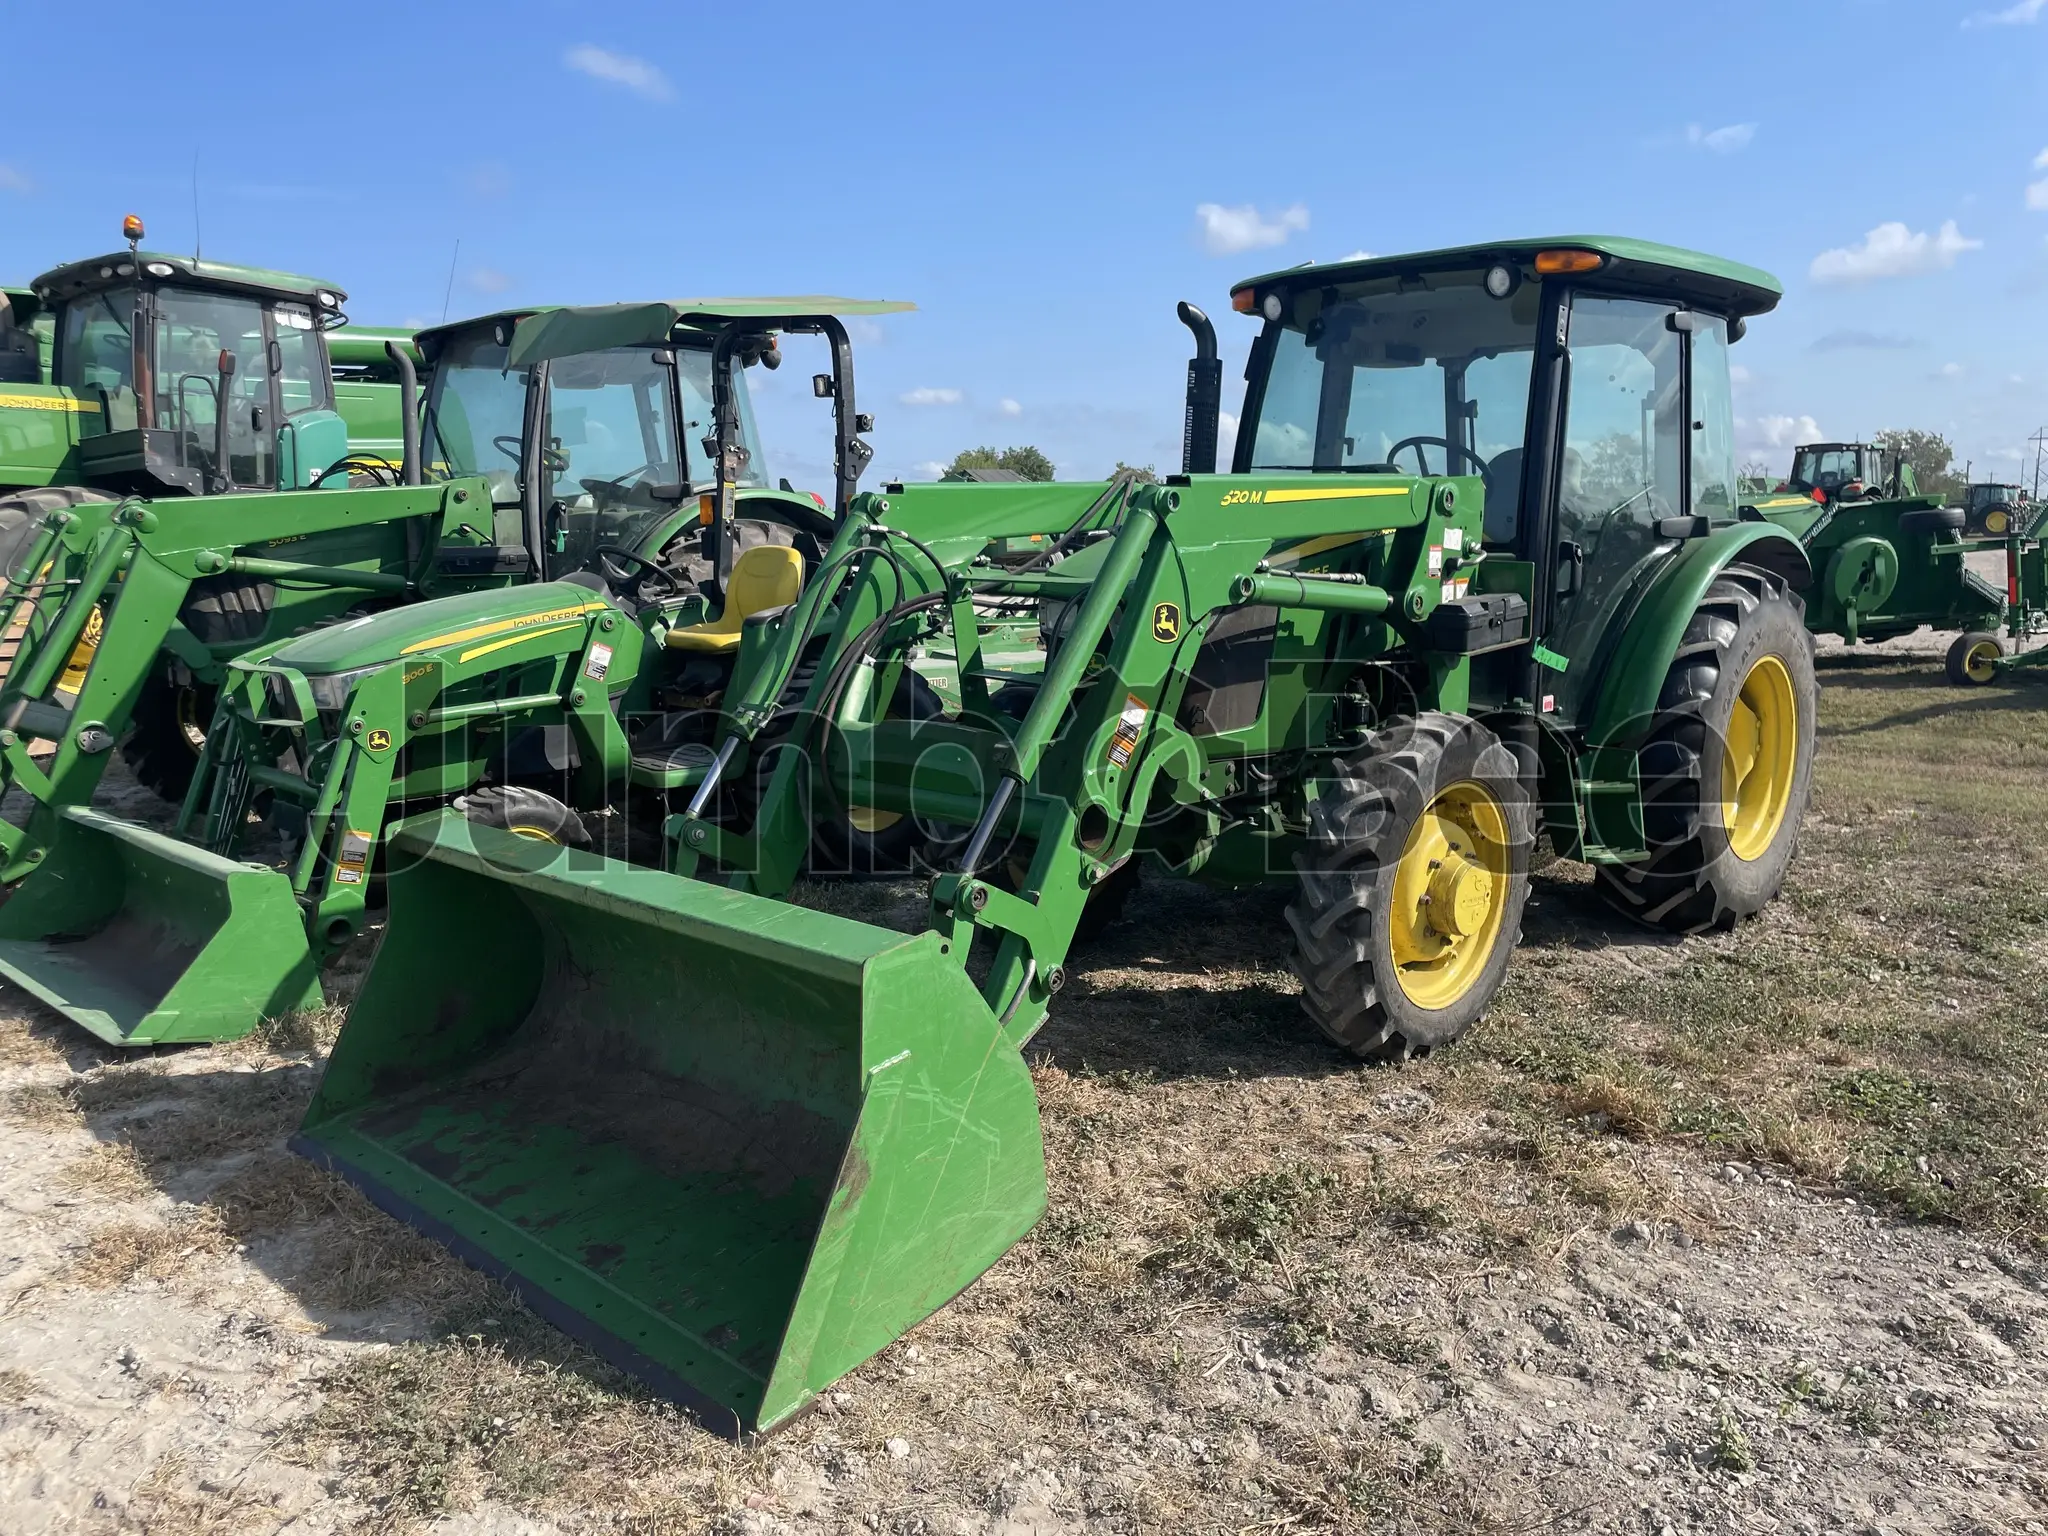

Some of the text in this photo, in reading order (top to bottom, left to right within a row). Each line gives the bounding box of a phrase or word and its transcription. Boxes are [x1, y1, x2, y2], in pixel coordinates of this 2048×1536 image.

[3, 398, 72, 410] JOHN DEERE
[1220, 490, 1262, 506] 520 M
[542, 610, 578, 623] DEERE
